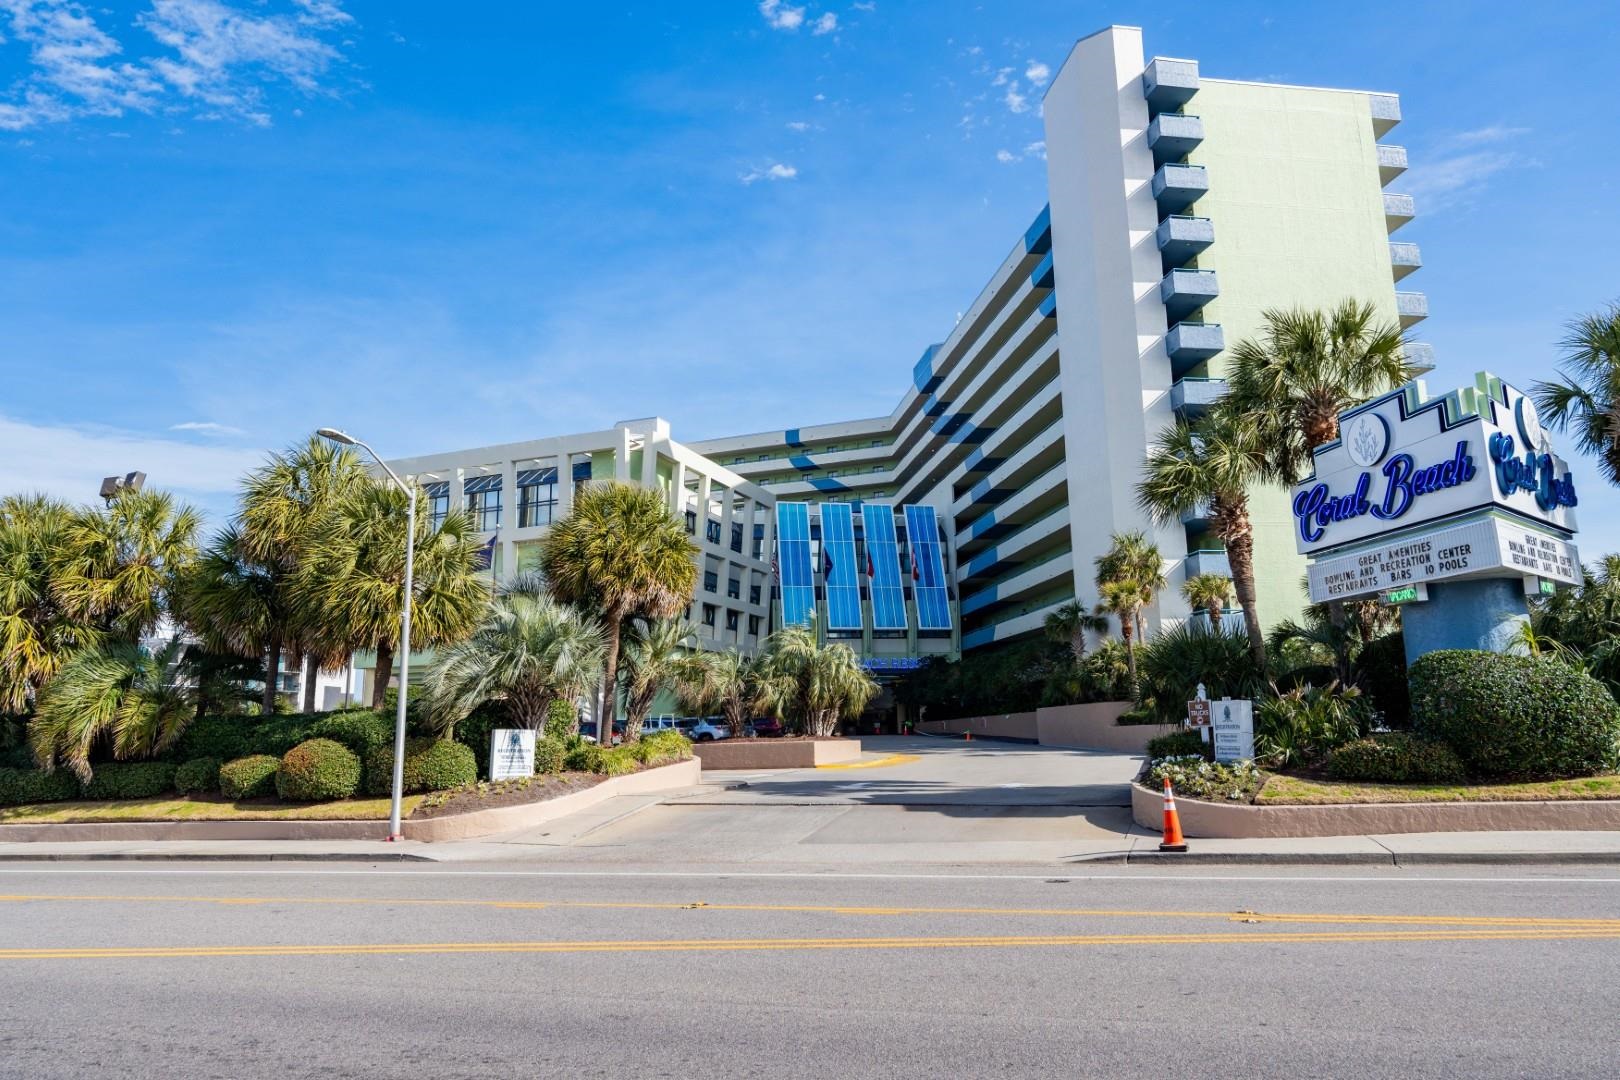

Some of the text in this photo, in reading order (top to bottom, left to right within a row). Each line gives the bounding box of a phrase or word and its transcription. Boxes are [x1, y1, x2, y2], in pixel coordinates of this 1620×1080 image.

[1293, 440, 1476, 543] Coral Beach
[1325, 544, 1471, 585] BOWLING AND RECREATION CENTER
[1358, 541, 1431, 566] GREAT AMENITIES
[1328, 577, 1378, 594] RESTAURANTS
[1391, 569, 1412, 582] BARS
[1439, 557, 1468, 571] POOLS
